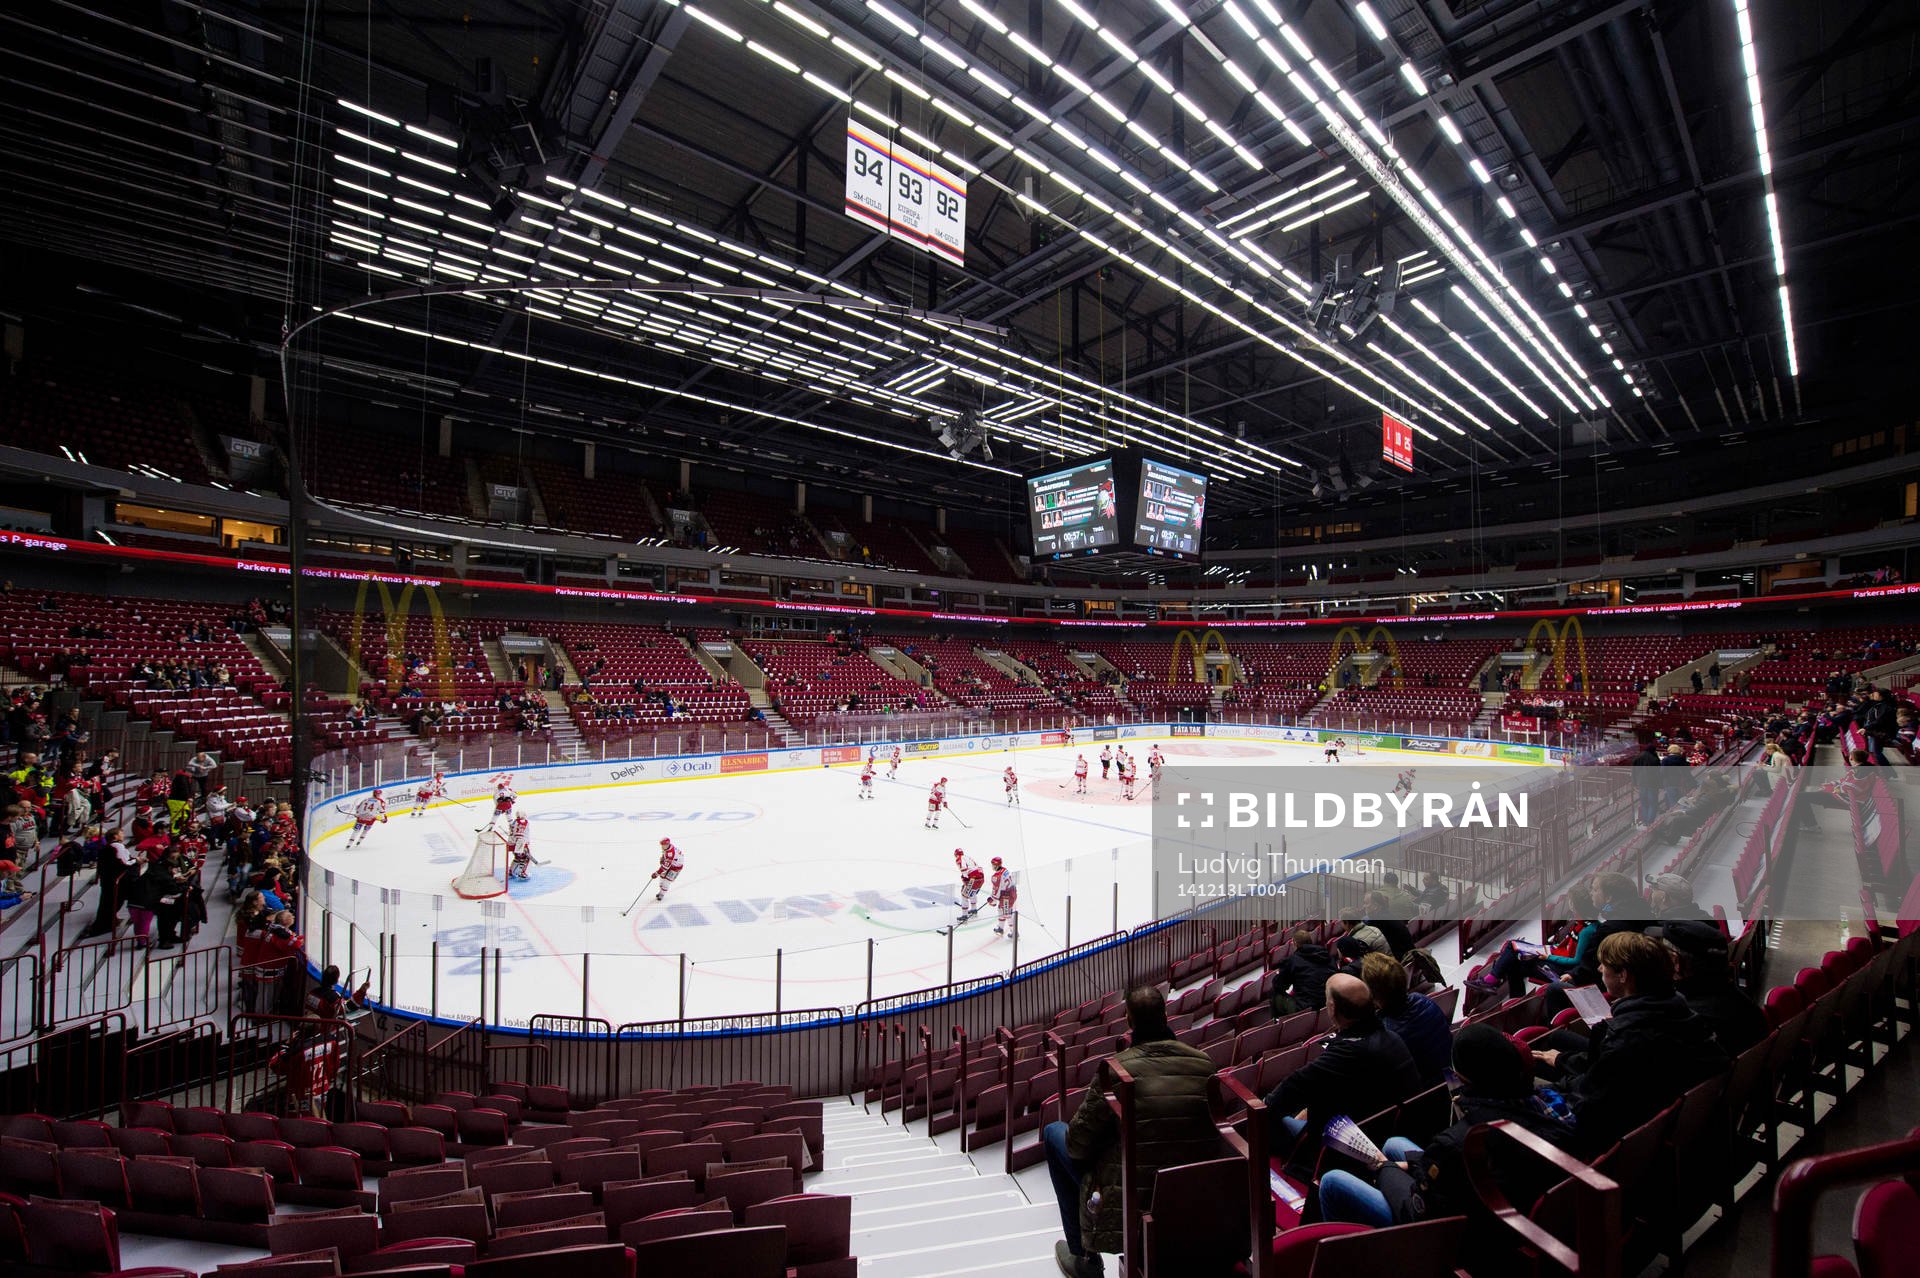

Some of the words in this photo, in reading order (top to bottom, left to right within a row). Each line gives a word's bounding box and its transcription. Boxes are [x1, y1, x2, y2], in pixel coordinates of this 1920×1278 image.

[854, 148, 883, 186] 94
[899, 172, 922, 205] 93
[853, 190, 882, 211] SM-GULD
[937, 190, 958, 222] 92
[12, 535, 67, 551] P-garage
[279, 567, 292, 575] me
[1009, 737, 1019, 746] EY
[610, 763, 646, 781] Delphi
[683, 761, 712, 772] Ocab
